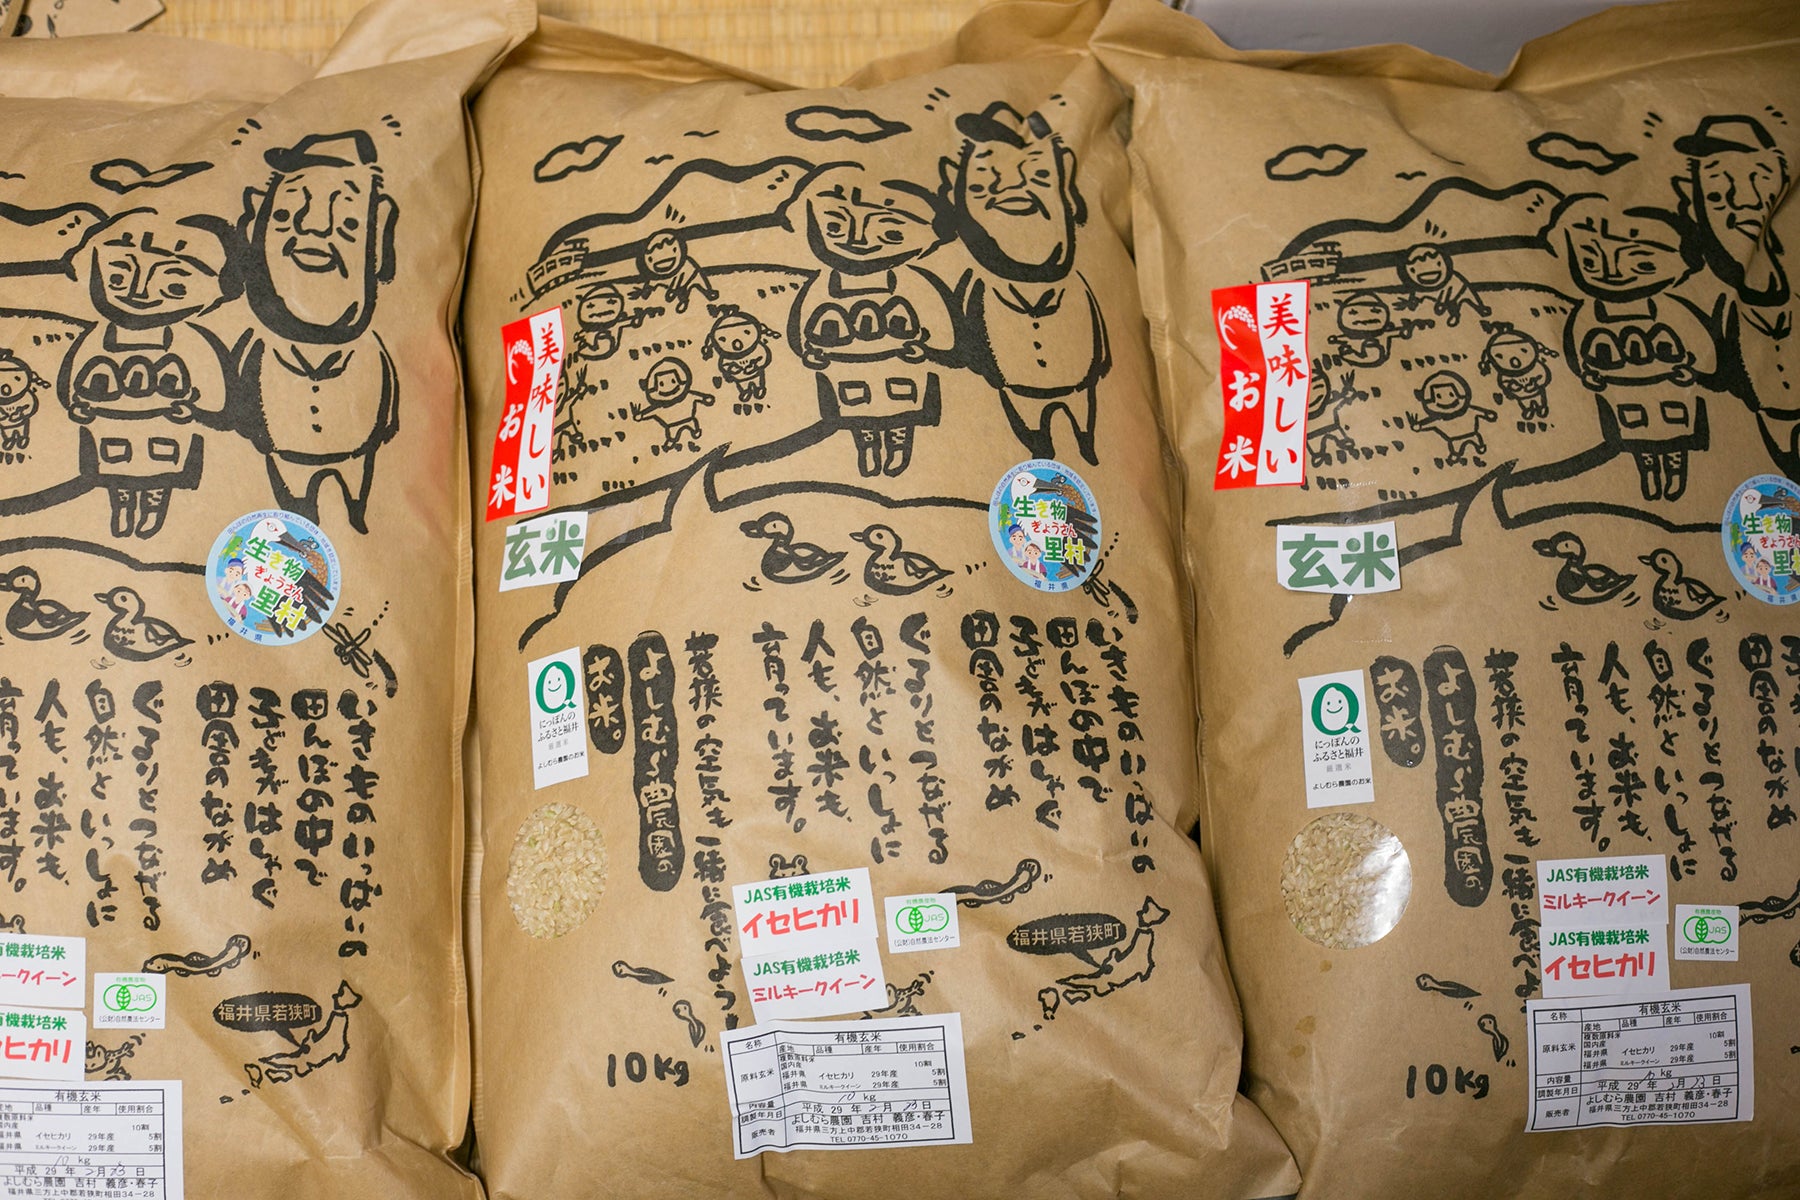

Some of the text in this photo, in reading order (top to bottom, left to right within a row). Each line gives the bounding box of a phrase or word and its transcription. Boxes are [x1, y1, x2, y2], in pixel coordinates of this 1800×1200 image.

[1262, 293, 1307, 474] 美味しい
[522, 322, 560, 501] 美味しい
[1218, 370, 1261, 480] お米
[489, 403, 525, 509] お米
[1014, 496, 1066, 521] 生き物
[1032, 520, 1077, 538] ぎょうさん
[1743, 512, 1792, 535] 生き物
[504, 519, 584, 581] 玄米
[1045, 536, 1085, 565] 里村
[245, 537, 304, 581] 生き物
[1282, 531, 1395, 589] 玄米
[255, 566, 303, 601] ぎょうさん
[1035, 580, 1069, 590] 福井県
[251, 586, 306, 629] 里村
[228, 617, 262, 641] 福井県
[960, 609, 1021, 812] 田舎のながめ
[1046, 616, 1113, 803] 田んぼの中で
[539, 712, 576, 729] にっぽんの
[538, 722, 579, 742] ふるさと福井
[850, 616, 902, 864] 自然といっしょに
[900, 612, 951, 864] ぐるりとつながる
[1739, 633, 1797, 830] 田舎のながめ
[1315, 736, 1360, 749] にっぽんの
[1313, 747, 1364, 762] ふるさと福井
[1643, 639, 1697, 881] 自然といっしょに
[1687, 637, 1738, 882] ぐるりとつながる
[196, 680, 240, 885] 田舎のながめ
[291, 689, 338, 886] 田んぼの中で
[81, 679, 126, 927] 自然といっしょに
[129, 680, 167, 931] ぐるりとつながる
[337, 689, 382, 957] いきものいっぱいの
[1546, 864, 1650, 883] JAS有機栽培米
[744, 876, 851, 904] JAS有機栽培米
[1543, 889, 1661, 910] ミルキークイーン
[742, 898, 859, 939] イセヒカリ
[924, 913, 945, 922] JAS
[1013, 922, 1121, 946] 福井県若狭町
[1549, 929, 1650, 947] JAS有機栽培米
[1709, 926, 1727, 934] JAS
[753, 949, 860, 976] JAS有機栽培米
[1545, 951, 1655, 981] イセヒカリ
[752, 974, 876, 1002] ミルキークイーン
[131, 994, 152, 1002] JAS
[218, 1003, 318, 1022] 福井県若狭町
[1550, 1012, 1567, 1020] 名称
[1639, 1002, 1681, 1015] 有機玄米
[1696, 1012, 1727, 1022] 使用割合
[1665, 1016, 1681, 1025] 産年
[745, 1039, 762, 1050] 名称
[835, 1031, 882, 1043] 有機玄米
[899, 1042, 935, 1051] 使用割合
[1542, 1043, 1576, 1053] 原料玄米
[1584, 1049, 1608, 1058] 福井県
[1622, 1046, 1655, 1056] イセヒカリ
[1670, 1042, 1694, 1052] 29年産
[1583, 1059, 1607, 1069] 福井県
[1670, 1054, 1694, 1064] 29年産
[819, 1072, 854, 1080] イセヒカリ
[871, 1070, 898, 1078] 29年産
[1547, 1075, 1571, 1084] 内容量
[1661, 1068, 1672, 1078] kg
[872, 1080, 899, 1088] 29年産
[1598, 1076, 1720, 1091] 平成 29 年 月 日
[55, 1090, 101, 1102] 有機玄米
[1586, 1093, 1646, 1105] よしむら農園
[1655, 1092, 1676, 1102] 吉村
[118, 1105, 153, 1113] 使用割合
[802, 1101, 931, 1114] 平成 29 年 月 日
[1638, 1111, 1695, 1119] 0770-45-1070
[792, 1114, 852, 1125] よしむら農園
[862, 1113, 883, 1124] 吉村
[36, 1132, 71, 1140] イセヒカリ
[88, 1133, 115, 1141] 29年産
[847, 1133, 908, 1142] 0770-45-1070
[88, 1144, 115, 1152] 29年産
[45, 1167, 57, 1175] 29
[65, 1167, 75, 1176] 年
[136, 1168, 145, 1176] 日
